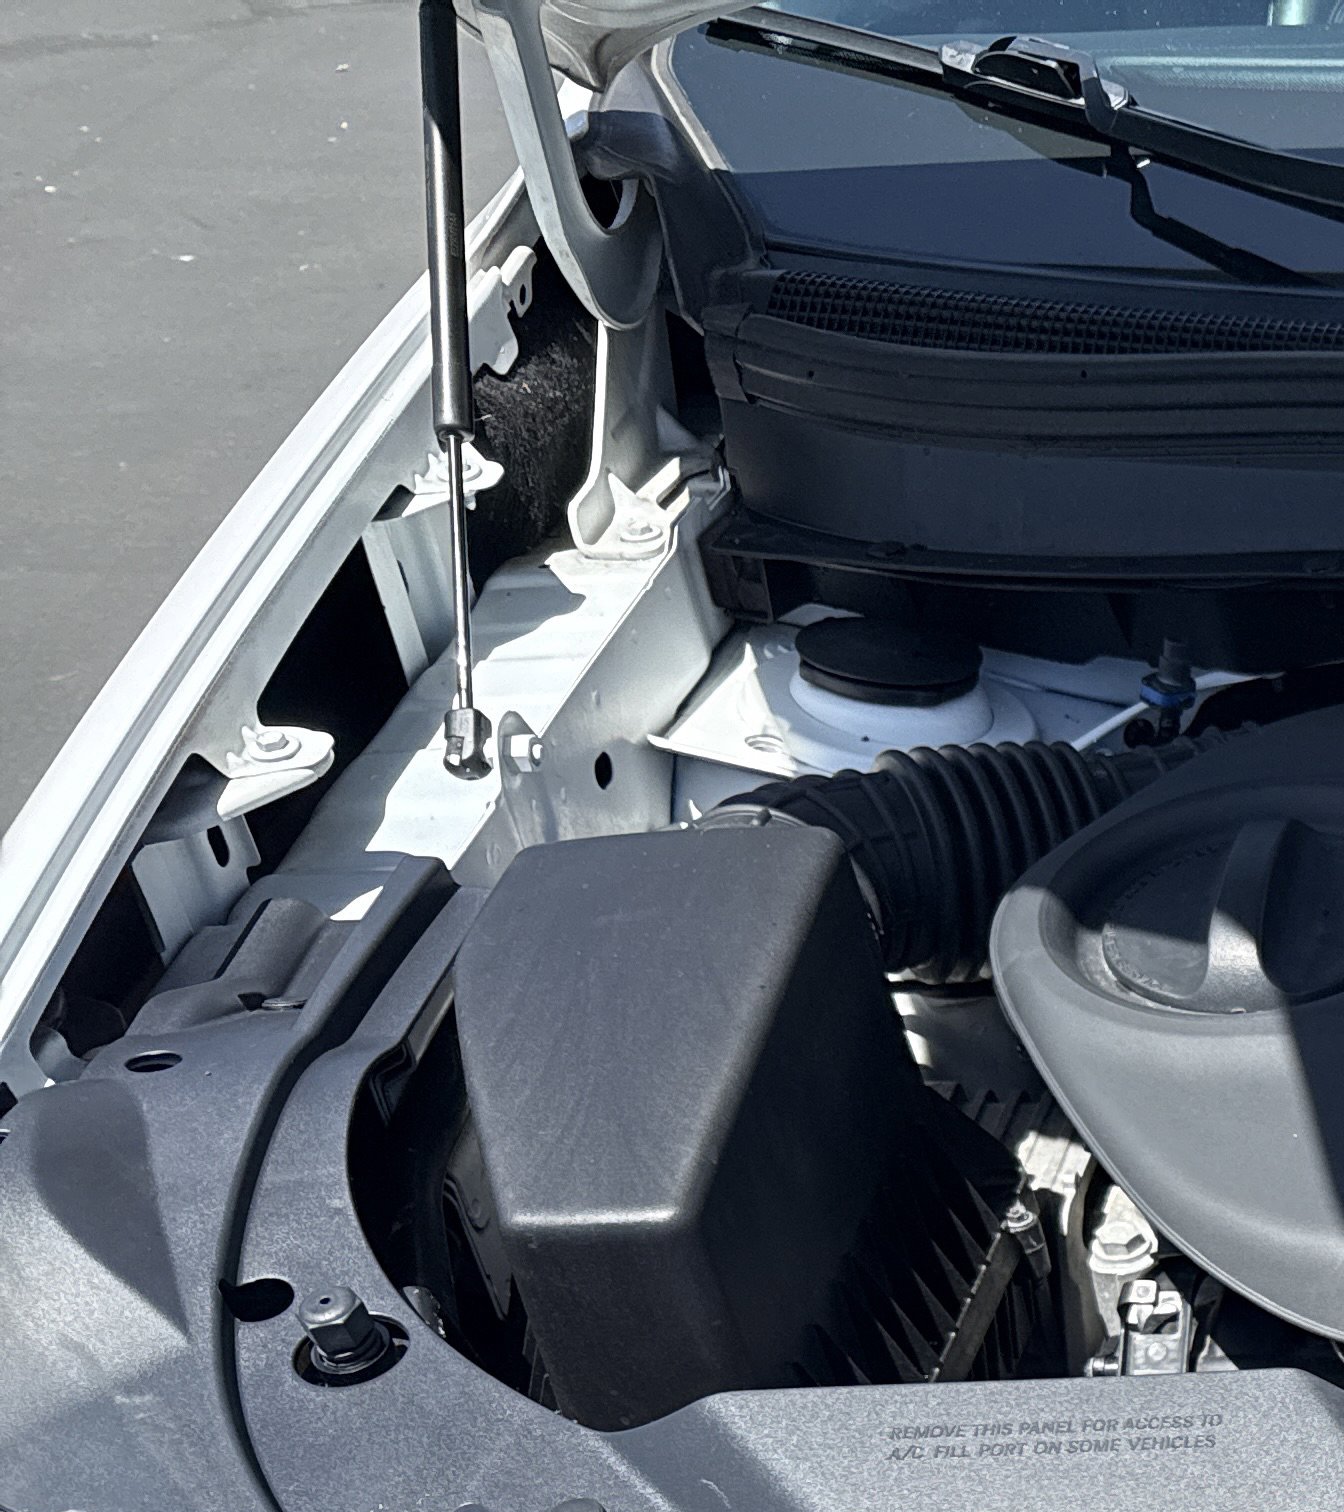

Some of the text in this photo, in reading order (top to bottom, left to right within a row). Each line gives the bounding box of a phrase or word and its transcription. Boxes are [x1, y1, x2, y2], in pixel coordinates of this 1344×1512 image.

[890, 1412, 1223, 1440] REMOVE THIS PANEL FOR ACCESS TO
[884, 1434, 1217, 1461] A/C FILL PORT ON SOME VEHICLES
